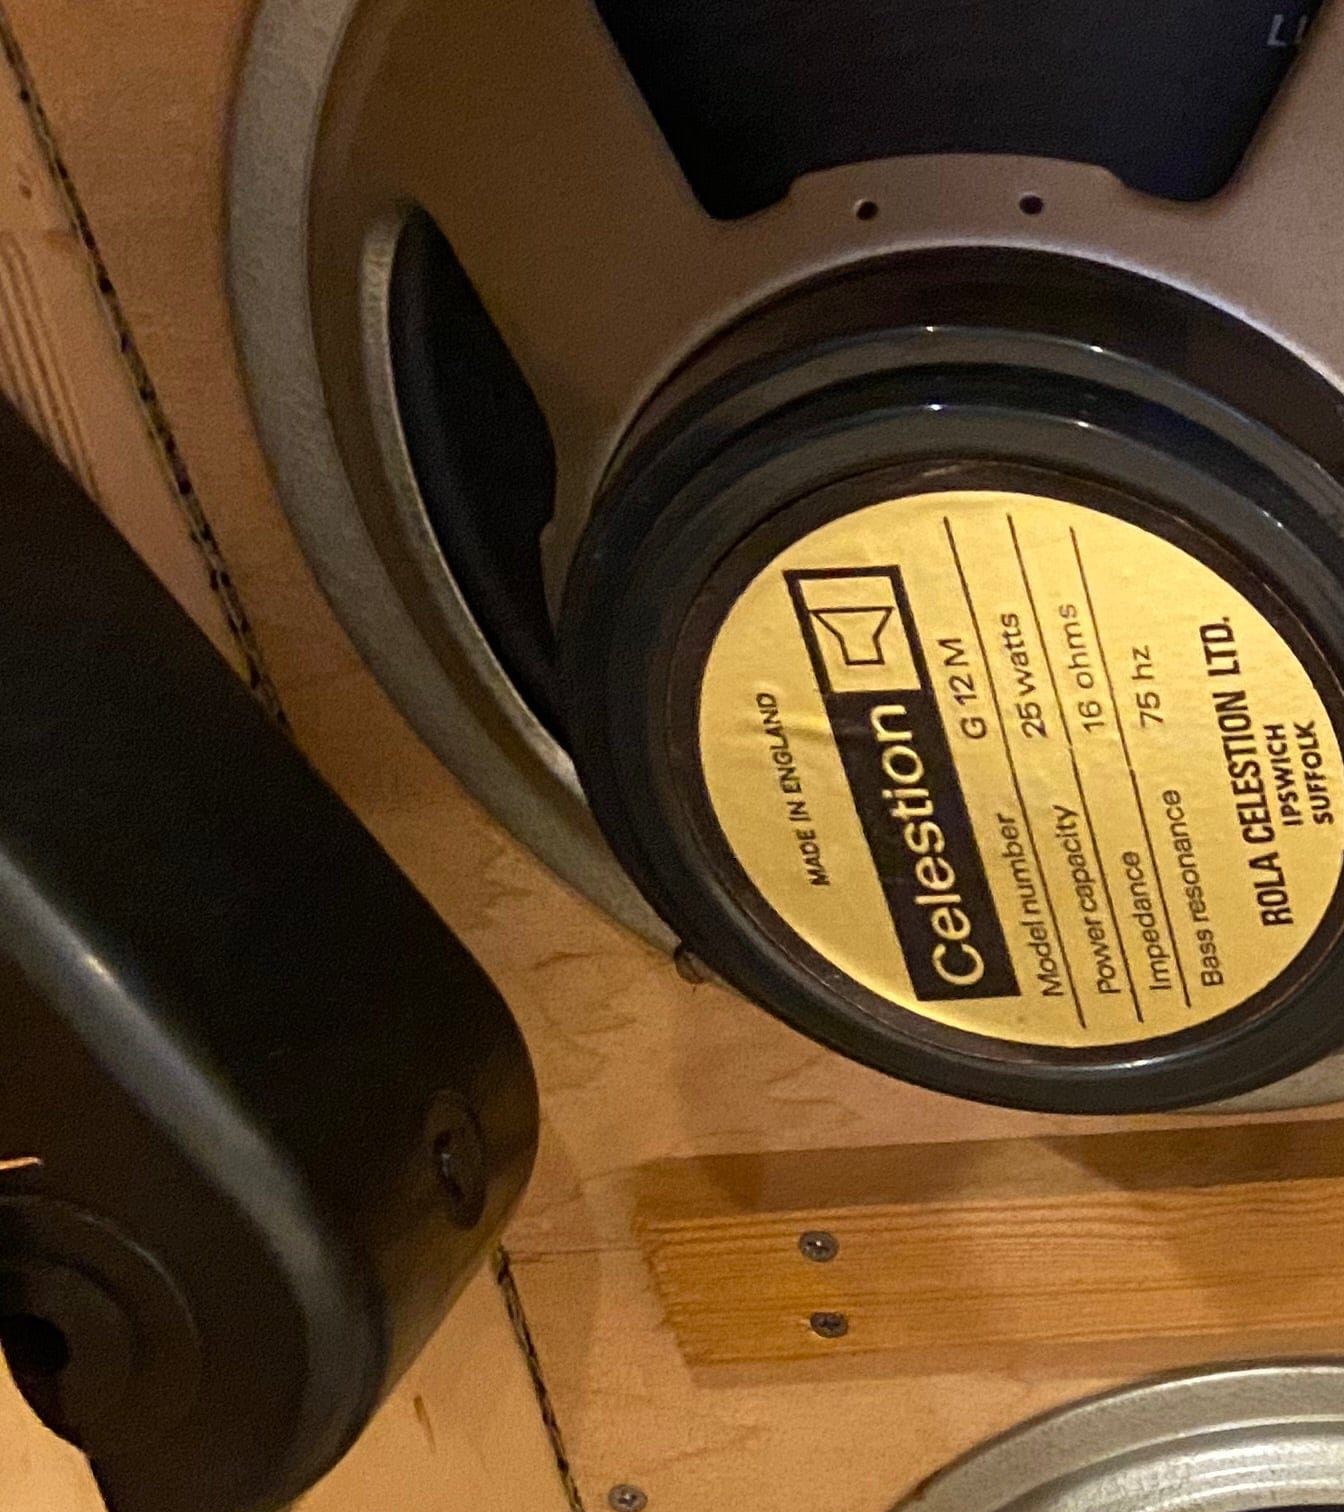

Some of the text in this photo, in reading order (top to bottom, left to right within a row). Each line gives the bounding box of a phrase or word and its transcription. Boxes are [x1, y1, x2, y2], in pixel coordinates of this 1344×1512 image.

[756, 692, 831, 887] MADE IN ENGLAND
[961, 716, 988, 741] G
[1001, 613, 1121, 995] Power capacity 25 watts
[1058, 603, 1172, 992] Impedance 16 ohms
[1131, 645, 1224, 987] Bass resonance 75 hz
[1200, 616, 1294, 928] ROLA CELESTION LTD.
[1264, 724, 1299, 827] IPSWICH
[1295, 721, 1334, 826] SUFFOLK
[870, 704, 986, 987] Celestion
[997, 813, 1039, 915] number
[1025, 925, 1064, 997] Model
